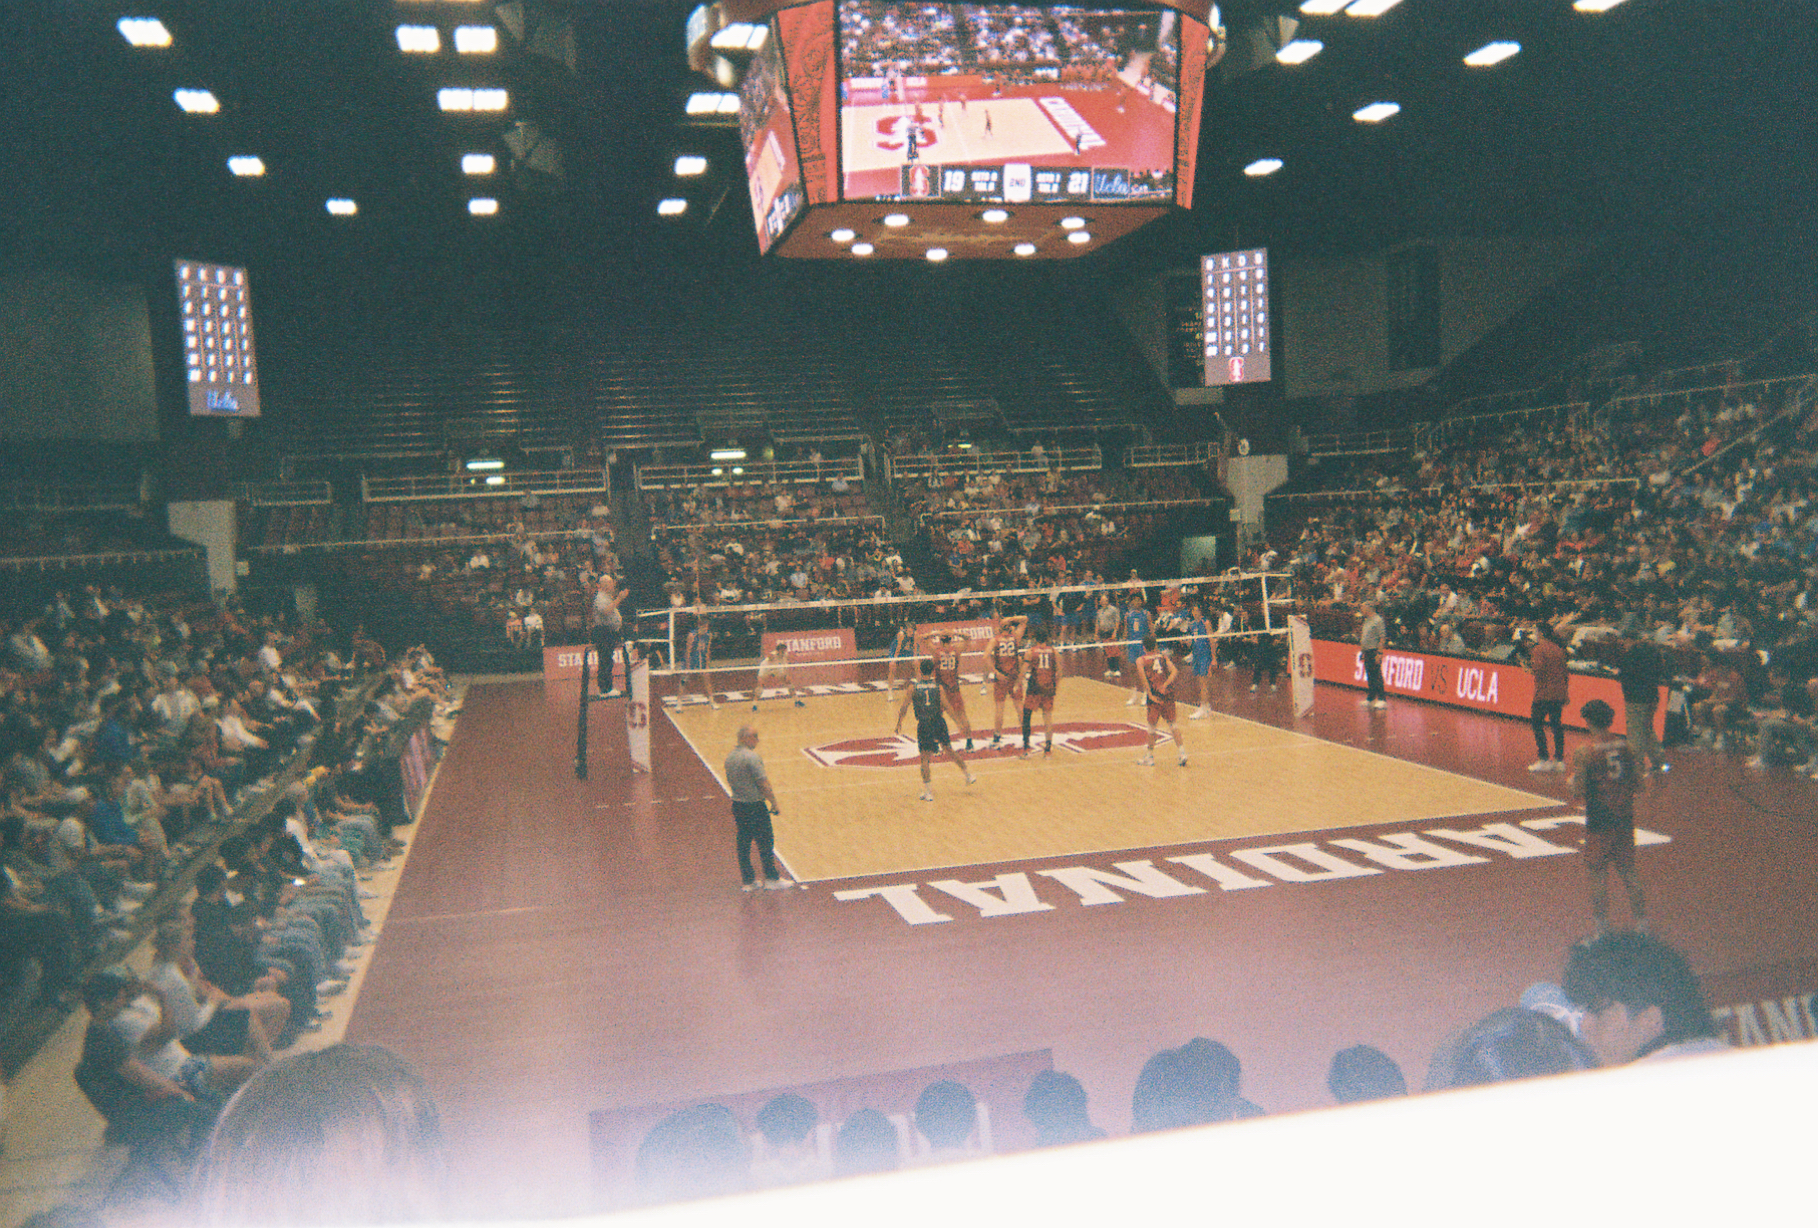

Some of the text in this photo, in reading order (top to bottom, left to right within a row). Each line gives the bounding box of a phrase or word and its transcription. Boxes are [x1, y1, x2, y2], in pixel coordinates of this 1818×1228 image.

[943, 170, 966, 192] 19
[1009, 178, 1026, 187] 2ND
[1067, 171, 1090, 194] 21
[999, 641, 1016, 657] 22
[1038, 653, 1050, 670] 11
[1152, 657, 1163, 675] 4
[1353, 650, 1499, 704] SNFORD VS UCLA
[1606, 751, 1622, 779] 5
[833, 814, 1674, 926] CARDINAL
